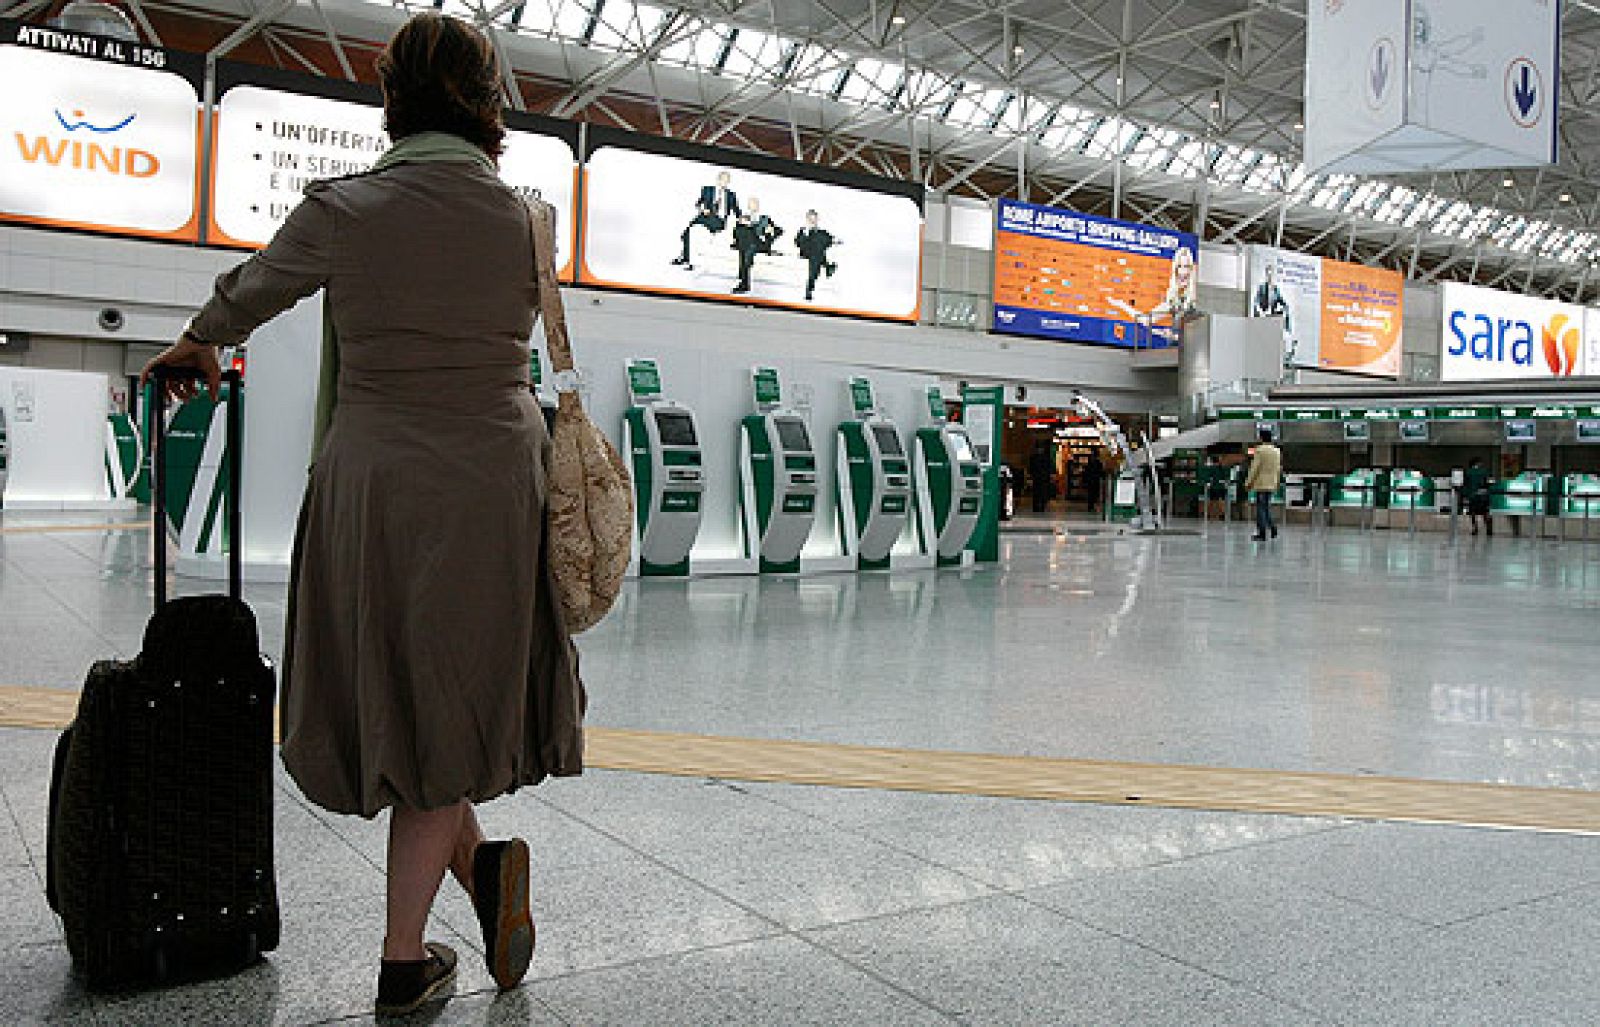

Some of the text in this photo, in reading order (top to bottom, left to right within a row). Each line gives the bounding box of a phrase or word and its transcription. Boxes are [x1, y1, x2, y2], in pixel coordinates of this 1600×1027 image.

[17, 26, 97, 56] ATTIVATI
[104, 41, 126, 60] AL
[272, 121, 385, 151] UN'OFFERTA
[15, 131, 160, 178] WIND
[272, 151, 299, 169] UN
